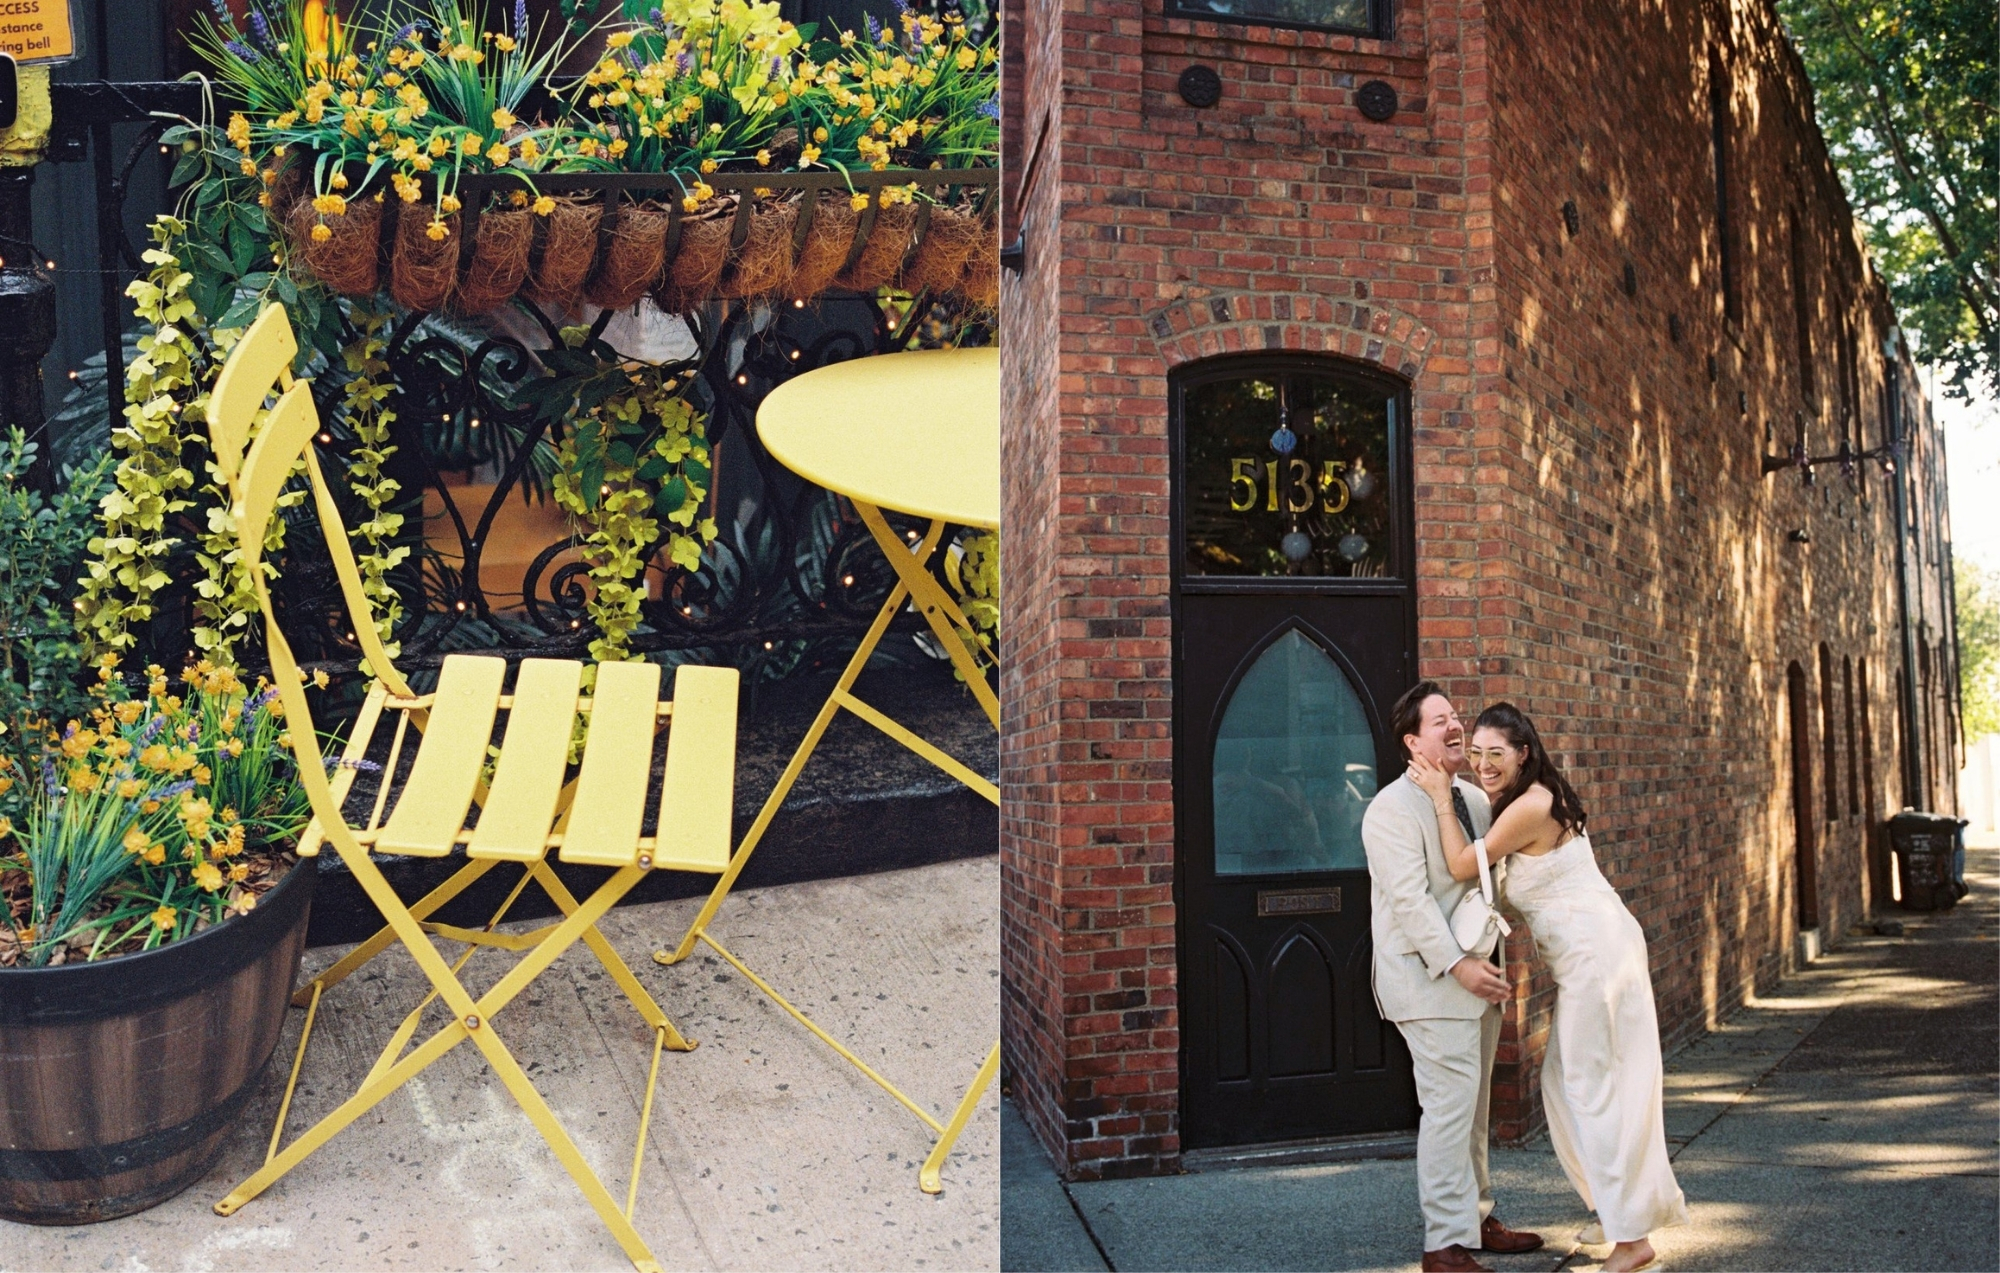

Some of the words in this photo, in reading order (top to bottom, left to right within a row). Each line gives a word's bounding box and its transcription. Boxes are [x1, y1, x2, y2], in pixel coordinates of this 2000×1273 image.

[1, 23, 43, 34] stance
[0, 41, 23, 54] ing
[27, 36, 50, 50] bell
[1231, 458, 1350, 514] 5135
